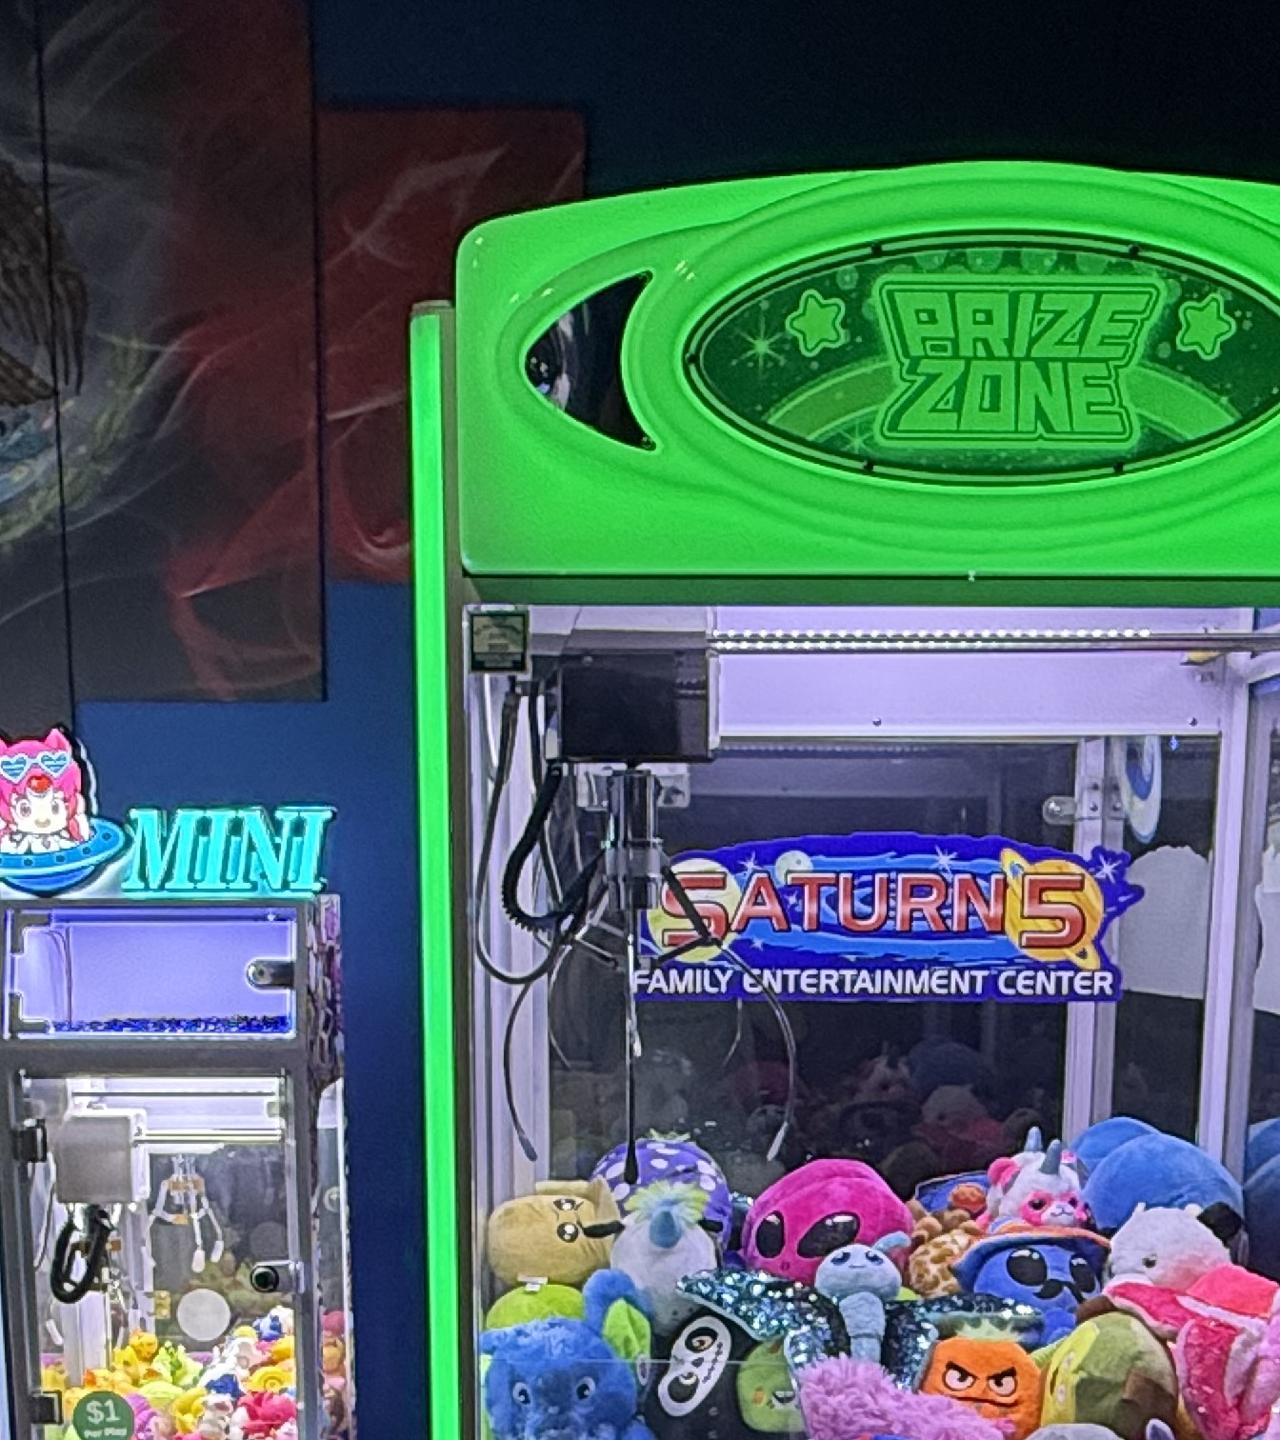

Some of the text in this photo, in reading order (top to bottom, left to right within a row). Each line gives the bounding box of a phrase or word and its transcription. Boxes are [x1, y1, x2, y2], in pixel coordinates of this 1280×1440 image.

[891, 290, 1152, 358] PRIZE
[894, 359, 1124, 433] ZONE
[121, 806, 334, 892] MINI
[662, 872, 1087, 949] SATURN 5
[632, 967, 1113, 996] FAMILY ENTERTAINMENT CENTER
[85, 1399, 121, 1424] $1
